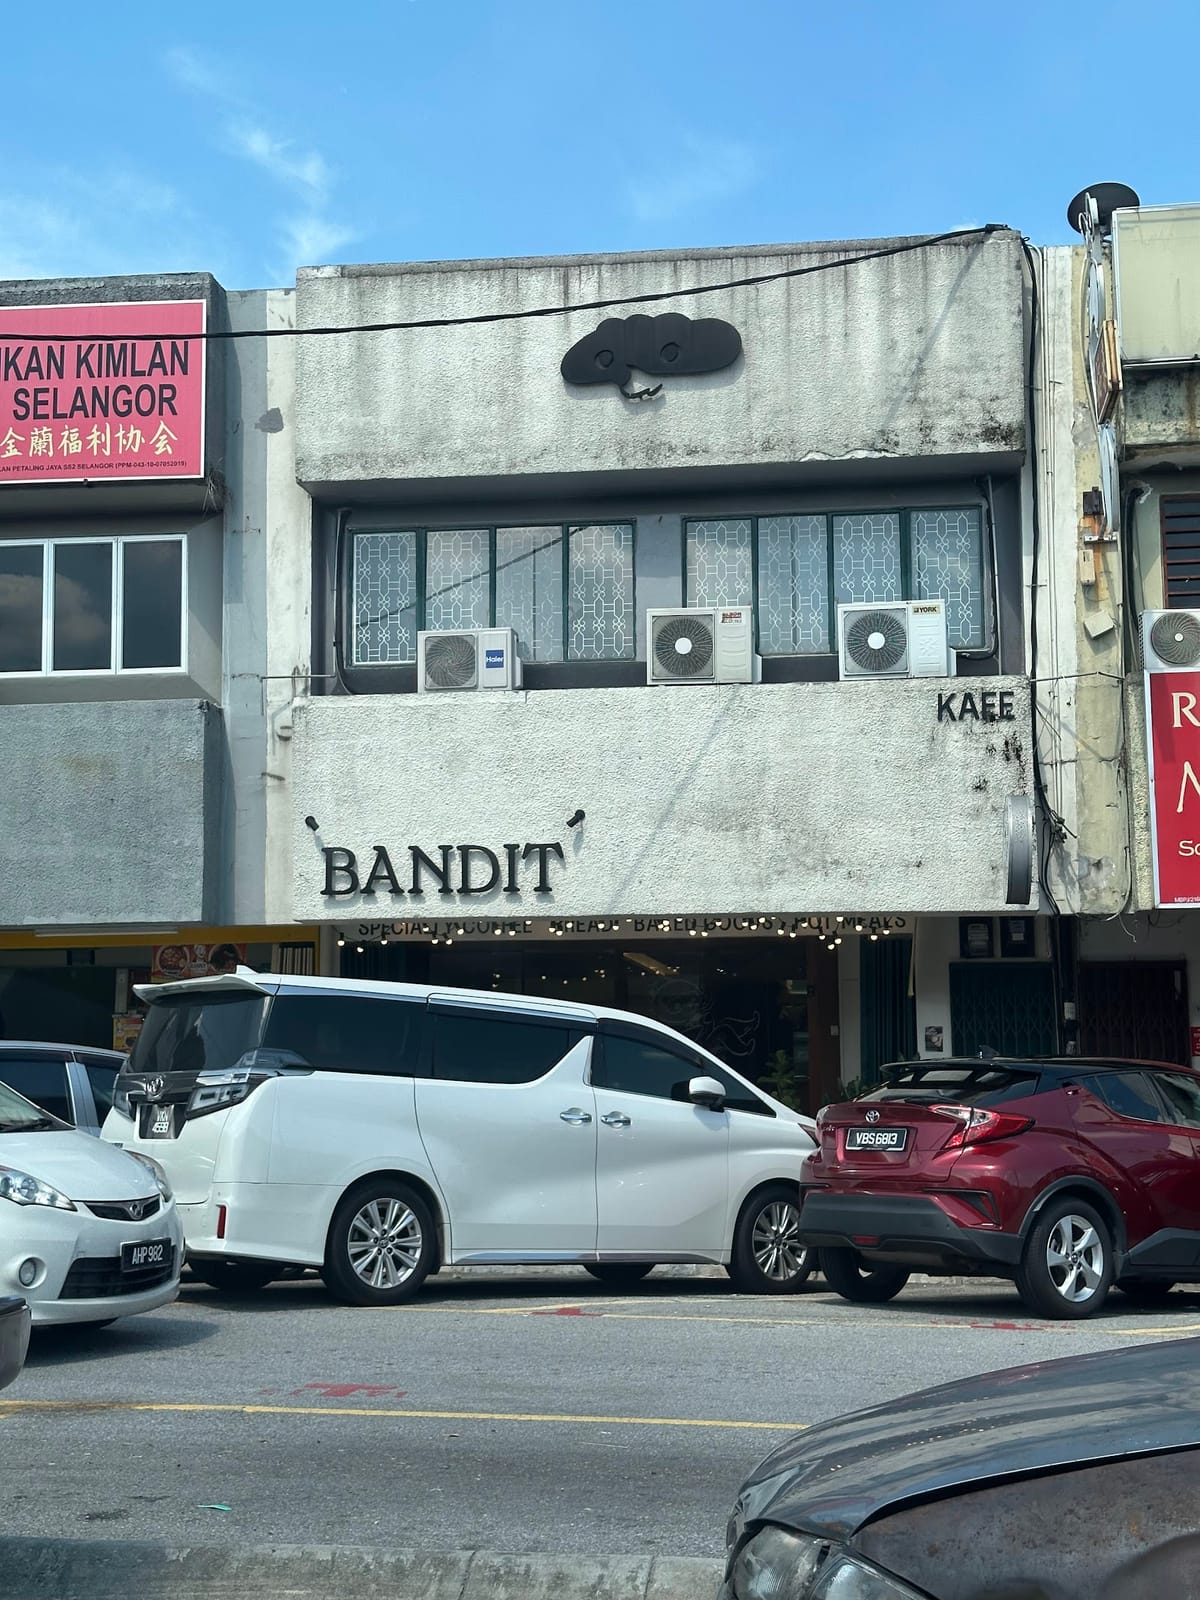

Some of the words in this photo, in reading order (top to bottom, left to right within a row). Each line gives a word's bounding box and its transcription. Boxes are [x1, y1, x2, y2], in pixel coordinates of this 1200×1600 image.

[0, 344, 65, 381] KAN
[76, 340, 188, 379] KIMLAN
[13, 384, 178, 421] SELANGOR
[0, 420, 178, 458] 金蘭福利协会
[12, 464, 45, 472] PETALING
[77, 462, 114, 470] SELANGOR
[486, 655, 504, 663] Haier
[320, 842, 564, 896] BANDIT
[634, 918, 697, 932] BAED
